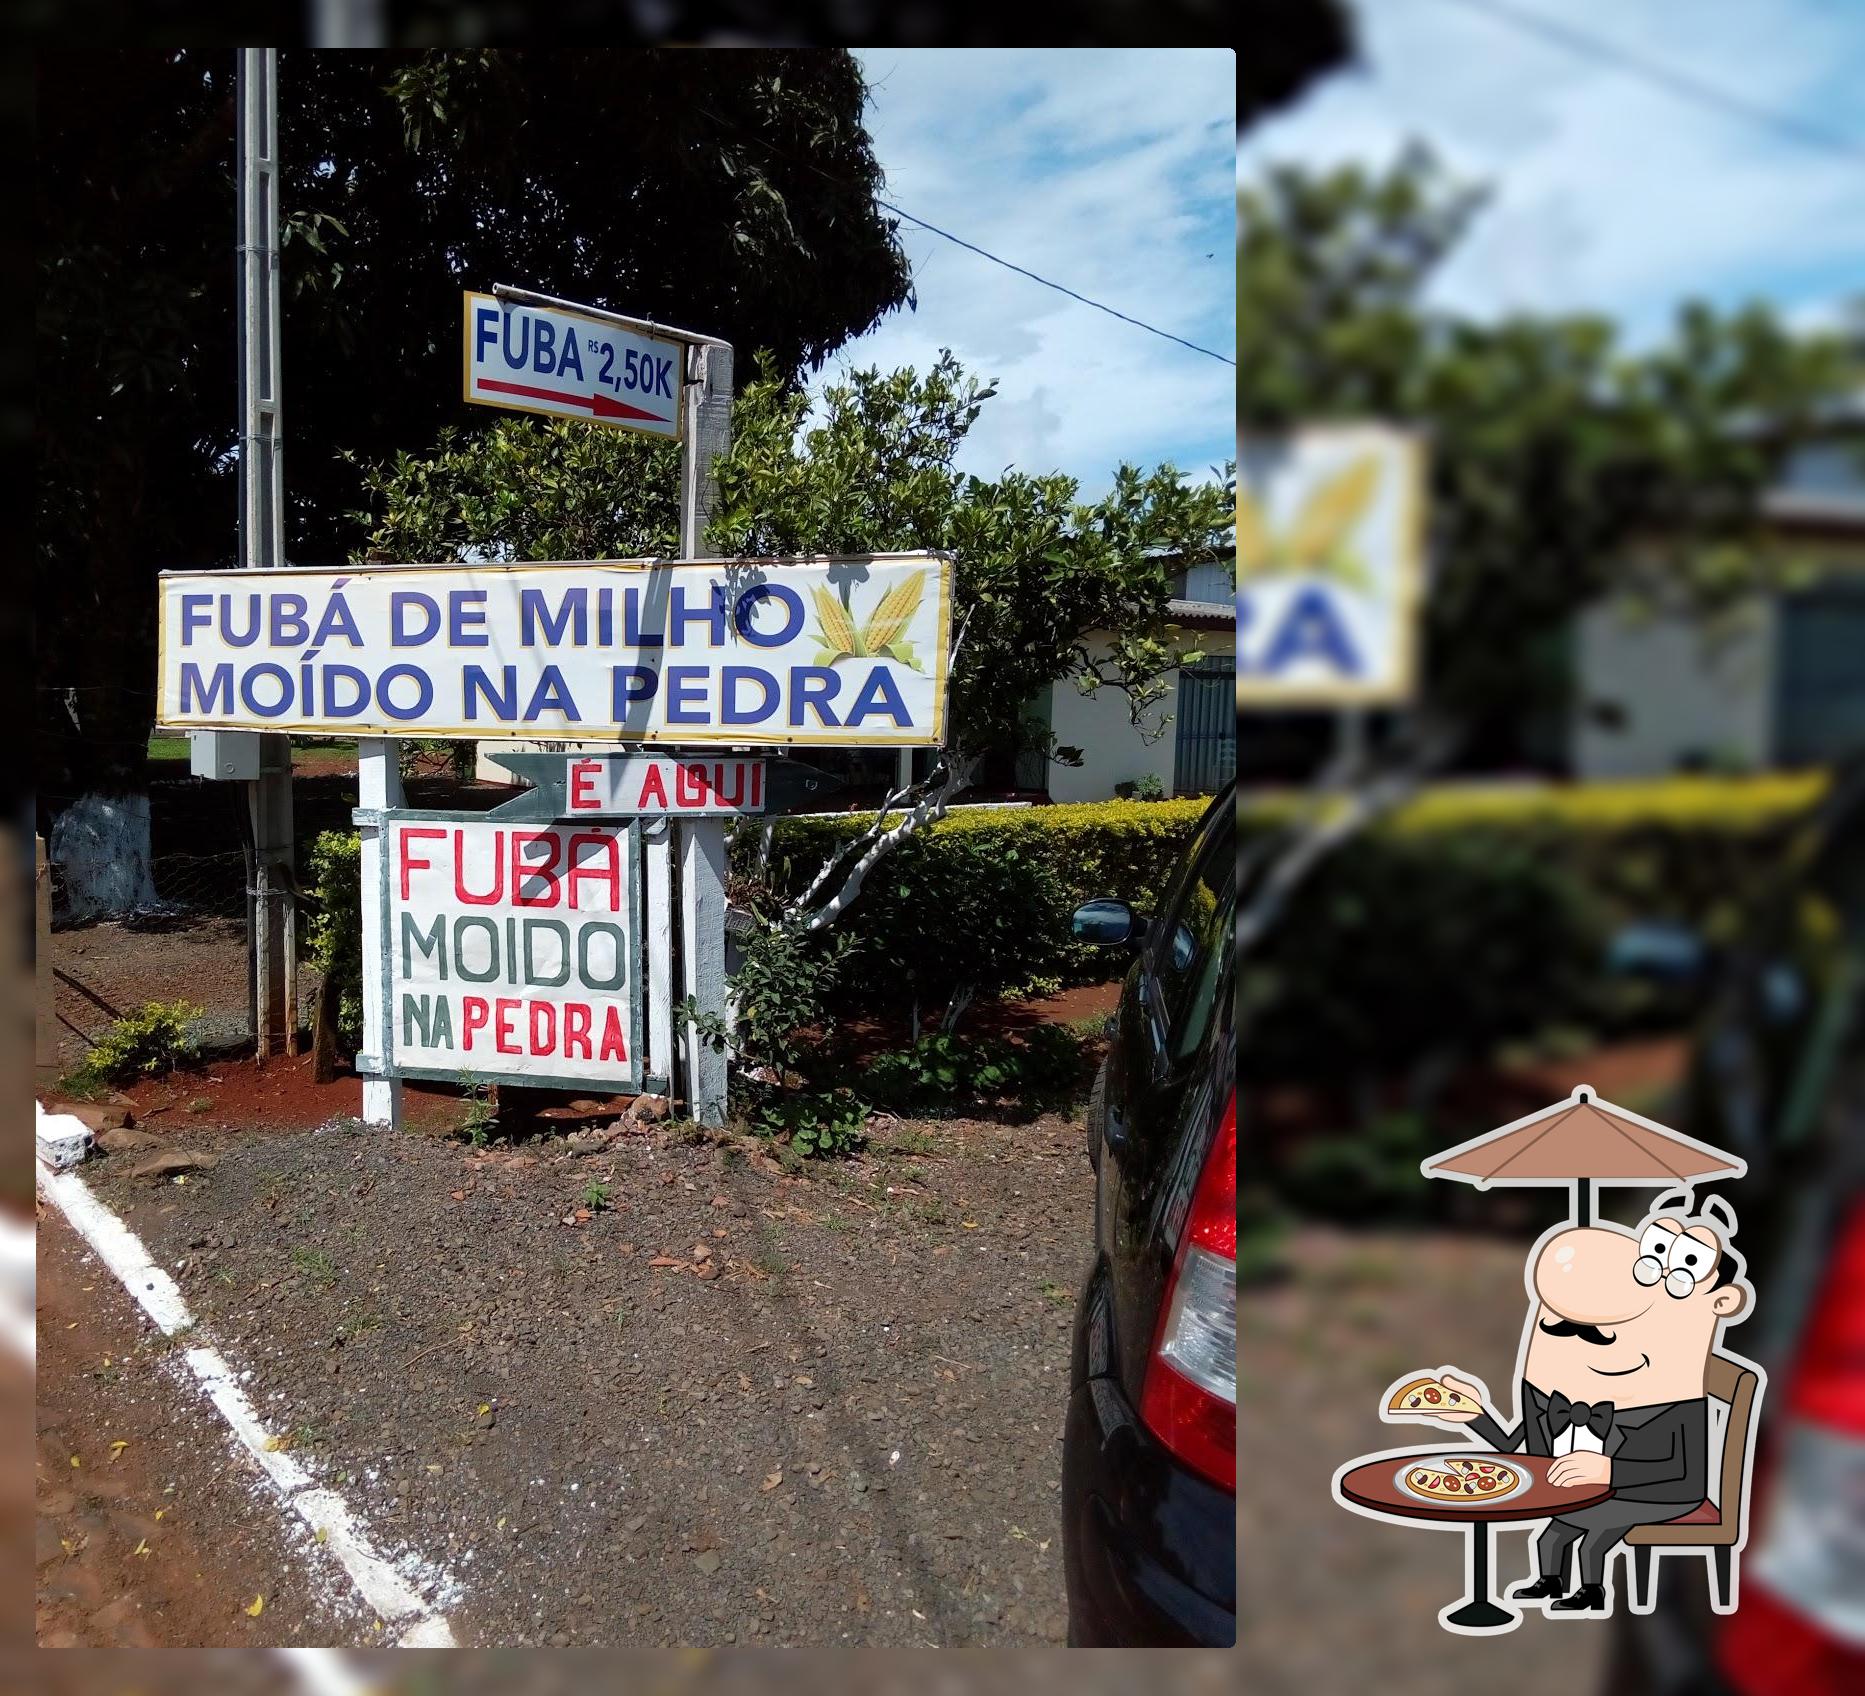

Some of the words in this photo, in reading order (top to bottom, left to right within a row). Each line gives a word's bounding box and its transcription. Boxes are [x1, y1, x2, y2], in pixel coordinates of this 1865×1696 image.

[476, 307, 584, 382] FUBA
[599, 342, 673, 400] 2,50K
[181, 577, 365, 648] FUBÁ
[390, 589, 489, 648] DE
[520, 583, 805, 648] MILHO
[180, 649, 434, 721] MOÍDO
[463, 664, 583, 722] NA
[612, 664, 915, 728] PEDRA
[572, 758, 603, 809] É
[638, 763, 763, 809] AQUI
[401, 911, 626, 991] MOIDO
[403, 994, 455, 1050] NA
[462, 996, 628, 1062] PEDRA
